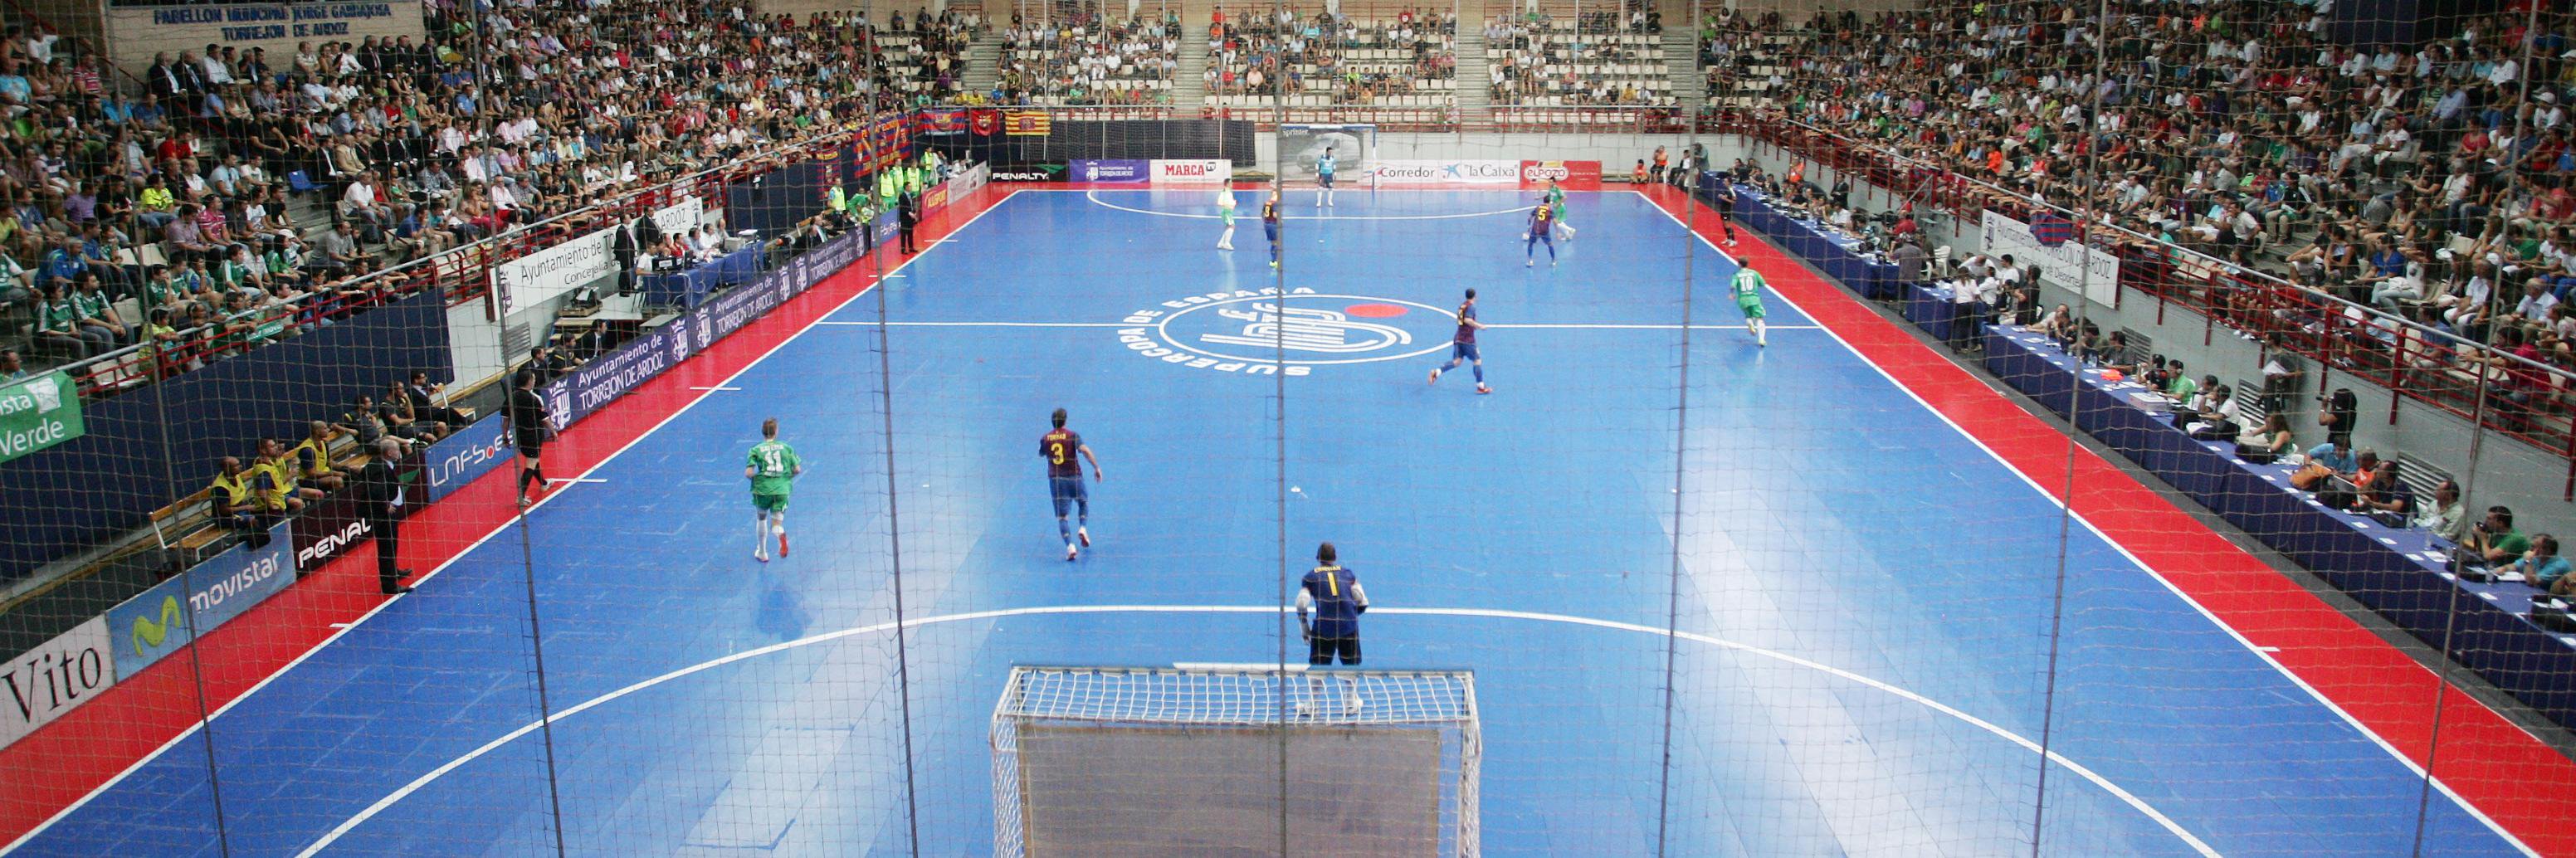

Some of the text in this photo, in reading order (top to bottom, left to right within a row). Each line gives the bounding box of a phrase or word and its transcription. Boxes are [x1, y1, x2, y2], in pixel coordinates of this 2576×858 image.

[293, 23, 310, 37] DE
[993, 172, 1047, 180] PENALTY
[1165, 164, 1204, 176] MARCA
[1381, 166, 1435, 178] Corredor
[1537, 208, 1547, 222] 5
[521, 248, 588, 285] Ayuntamiento
[591, 238, 602, 256] de
[715, 275, 773, 314] Ayuntamiento de
[1739, 276, 1754, 292] 10
[748, 300, 756, 318] DE
[755, 290, 775, 313] ARDOZ
[1123, 310, 1164, 324] DE
[1162, 286, 1315, 309] ESPAÑA
[578, 334, 663, 388] Ayuntamiento de
[624, 365, 638, 388] DE
[637, 350, 664, 382] ARDOZ
[0, 417, 65, 456] Verde
[764, 451, 784, 472] 11
[1051, 442, 1064, 466] 3
[299, 518, 372, 569] PENAL
[189, 549, 280, 615] movistar
[1327, 571, 1338, 597] 1
[0, 647, 102, 724] Vito
